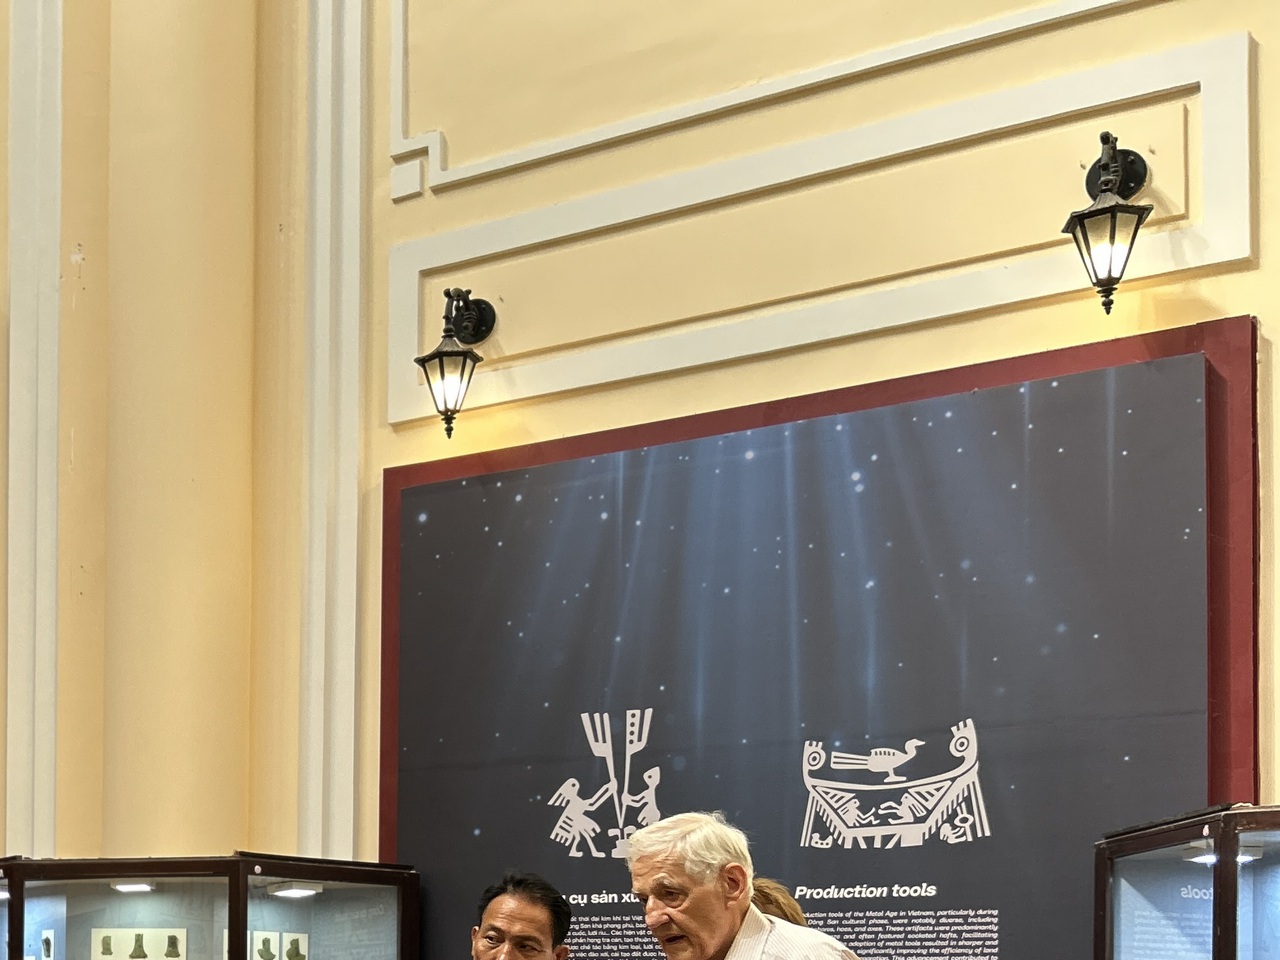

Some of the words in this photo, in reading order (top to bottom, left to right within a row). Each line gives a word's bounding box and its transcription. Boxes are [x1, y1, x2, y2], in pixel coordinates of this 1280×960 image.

[794, 884, 888, 899] Production
[891, 883, 937, 897] tools
[569, 894, 587, 906] cụ
[591, 890, 618, 903] sản
[884, 910, 898, 918] Age
[936, 909, 976, 917] particularly
[911, 917, 937, 925] notably
[967, 916, 999, 924] including
[876, 940, 885, 948] of
[940, 947, 974, 955] efficiency
[973, 947, 982, 955] of
